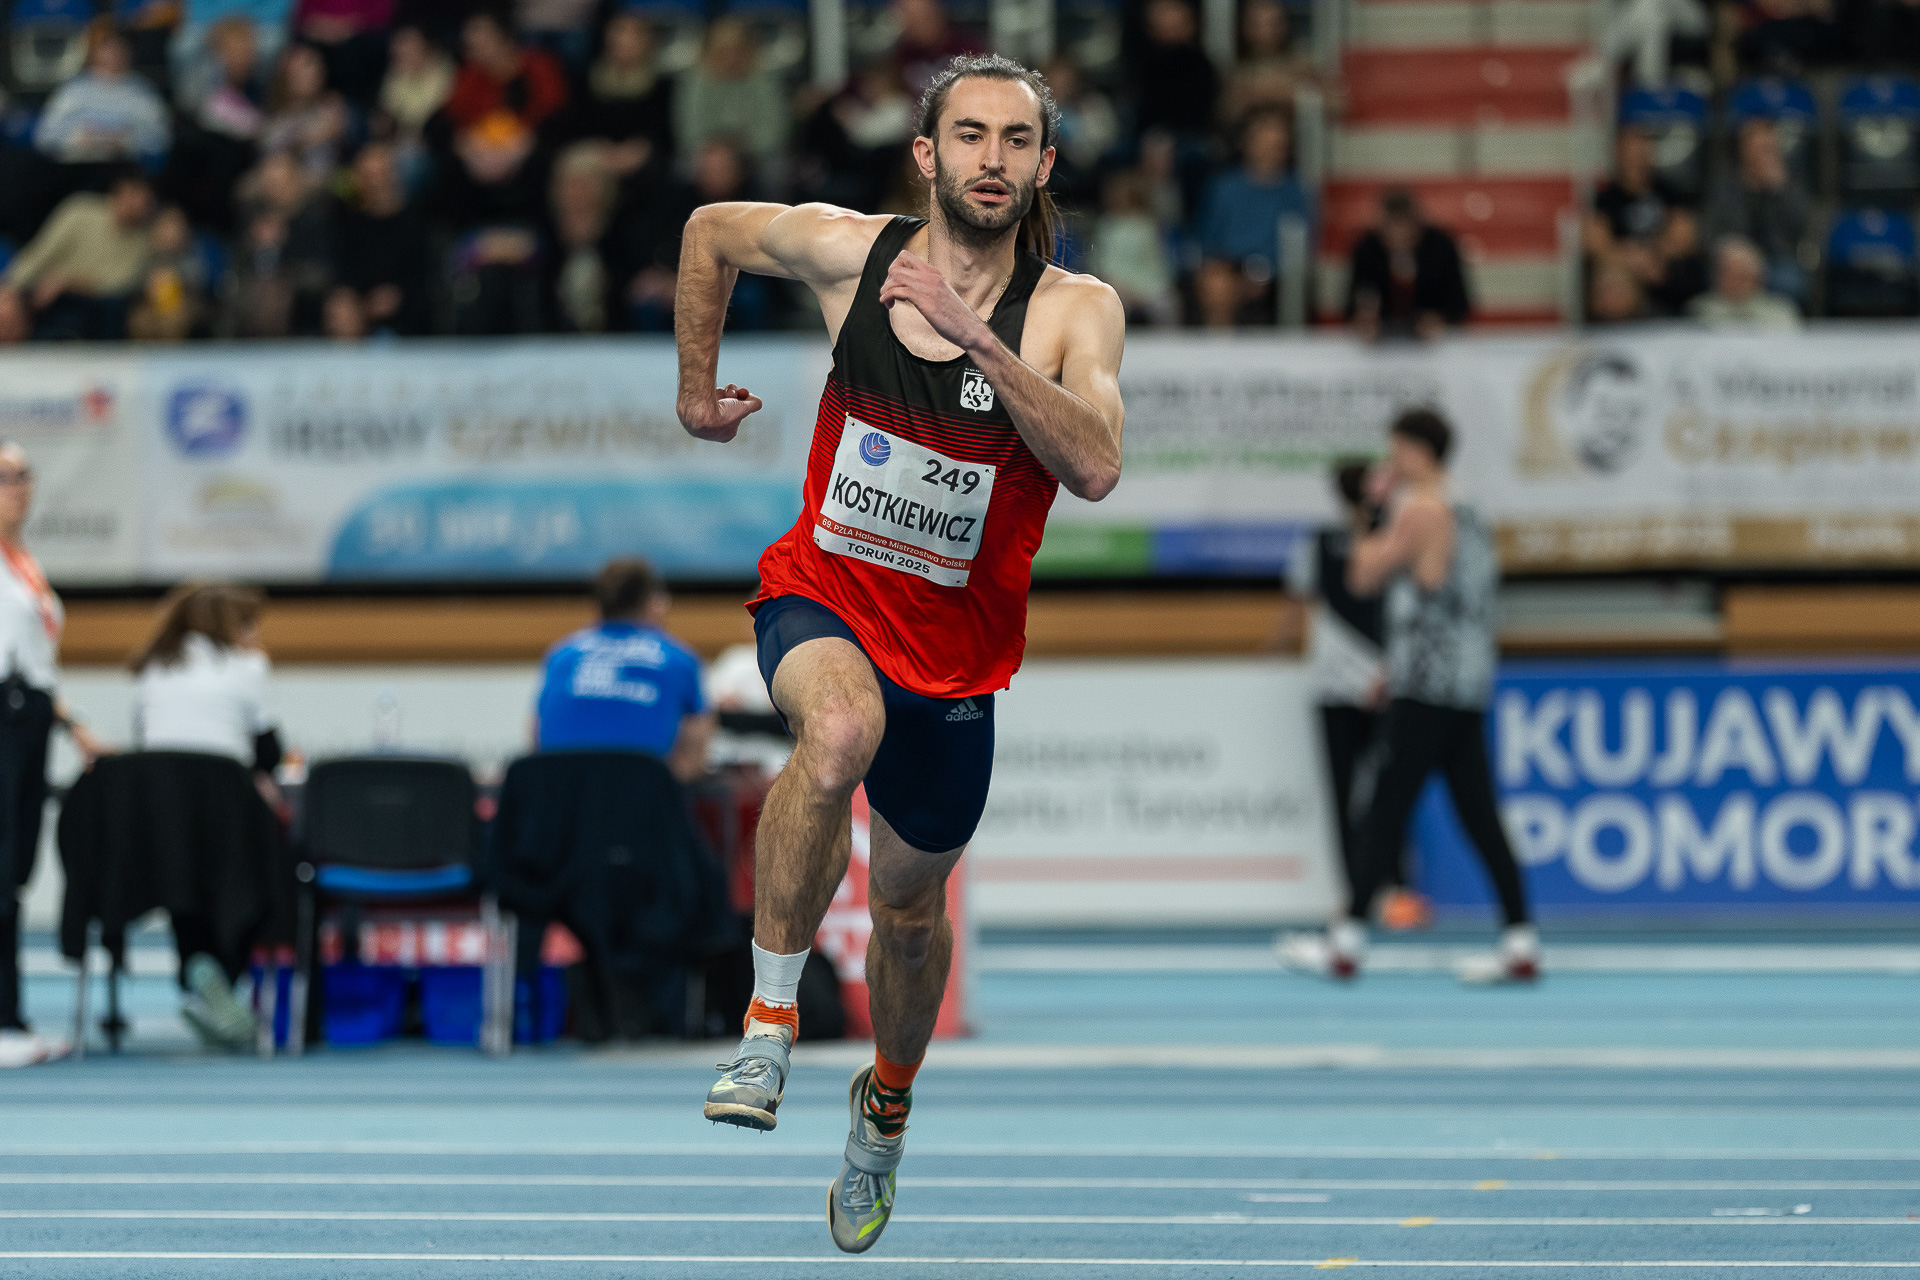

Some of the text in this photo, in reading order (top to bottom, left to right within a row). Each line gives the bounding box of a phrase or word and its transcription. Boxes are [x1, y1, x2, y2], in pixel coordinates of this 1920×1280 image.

[921, 458, 981, 495] 249
[832, 472, 977, 543] KOSTKIEWICZ
[822, 518, 966, 568] 69. PZLA Halowe Mistrzostwa Polski
[847, 541, 930, 574] TORUŃ 2025
[945, 710, 984, 721] adidas
